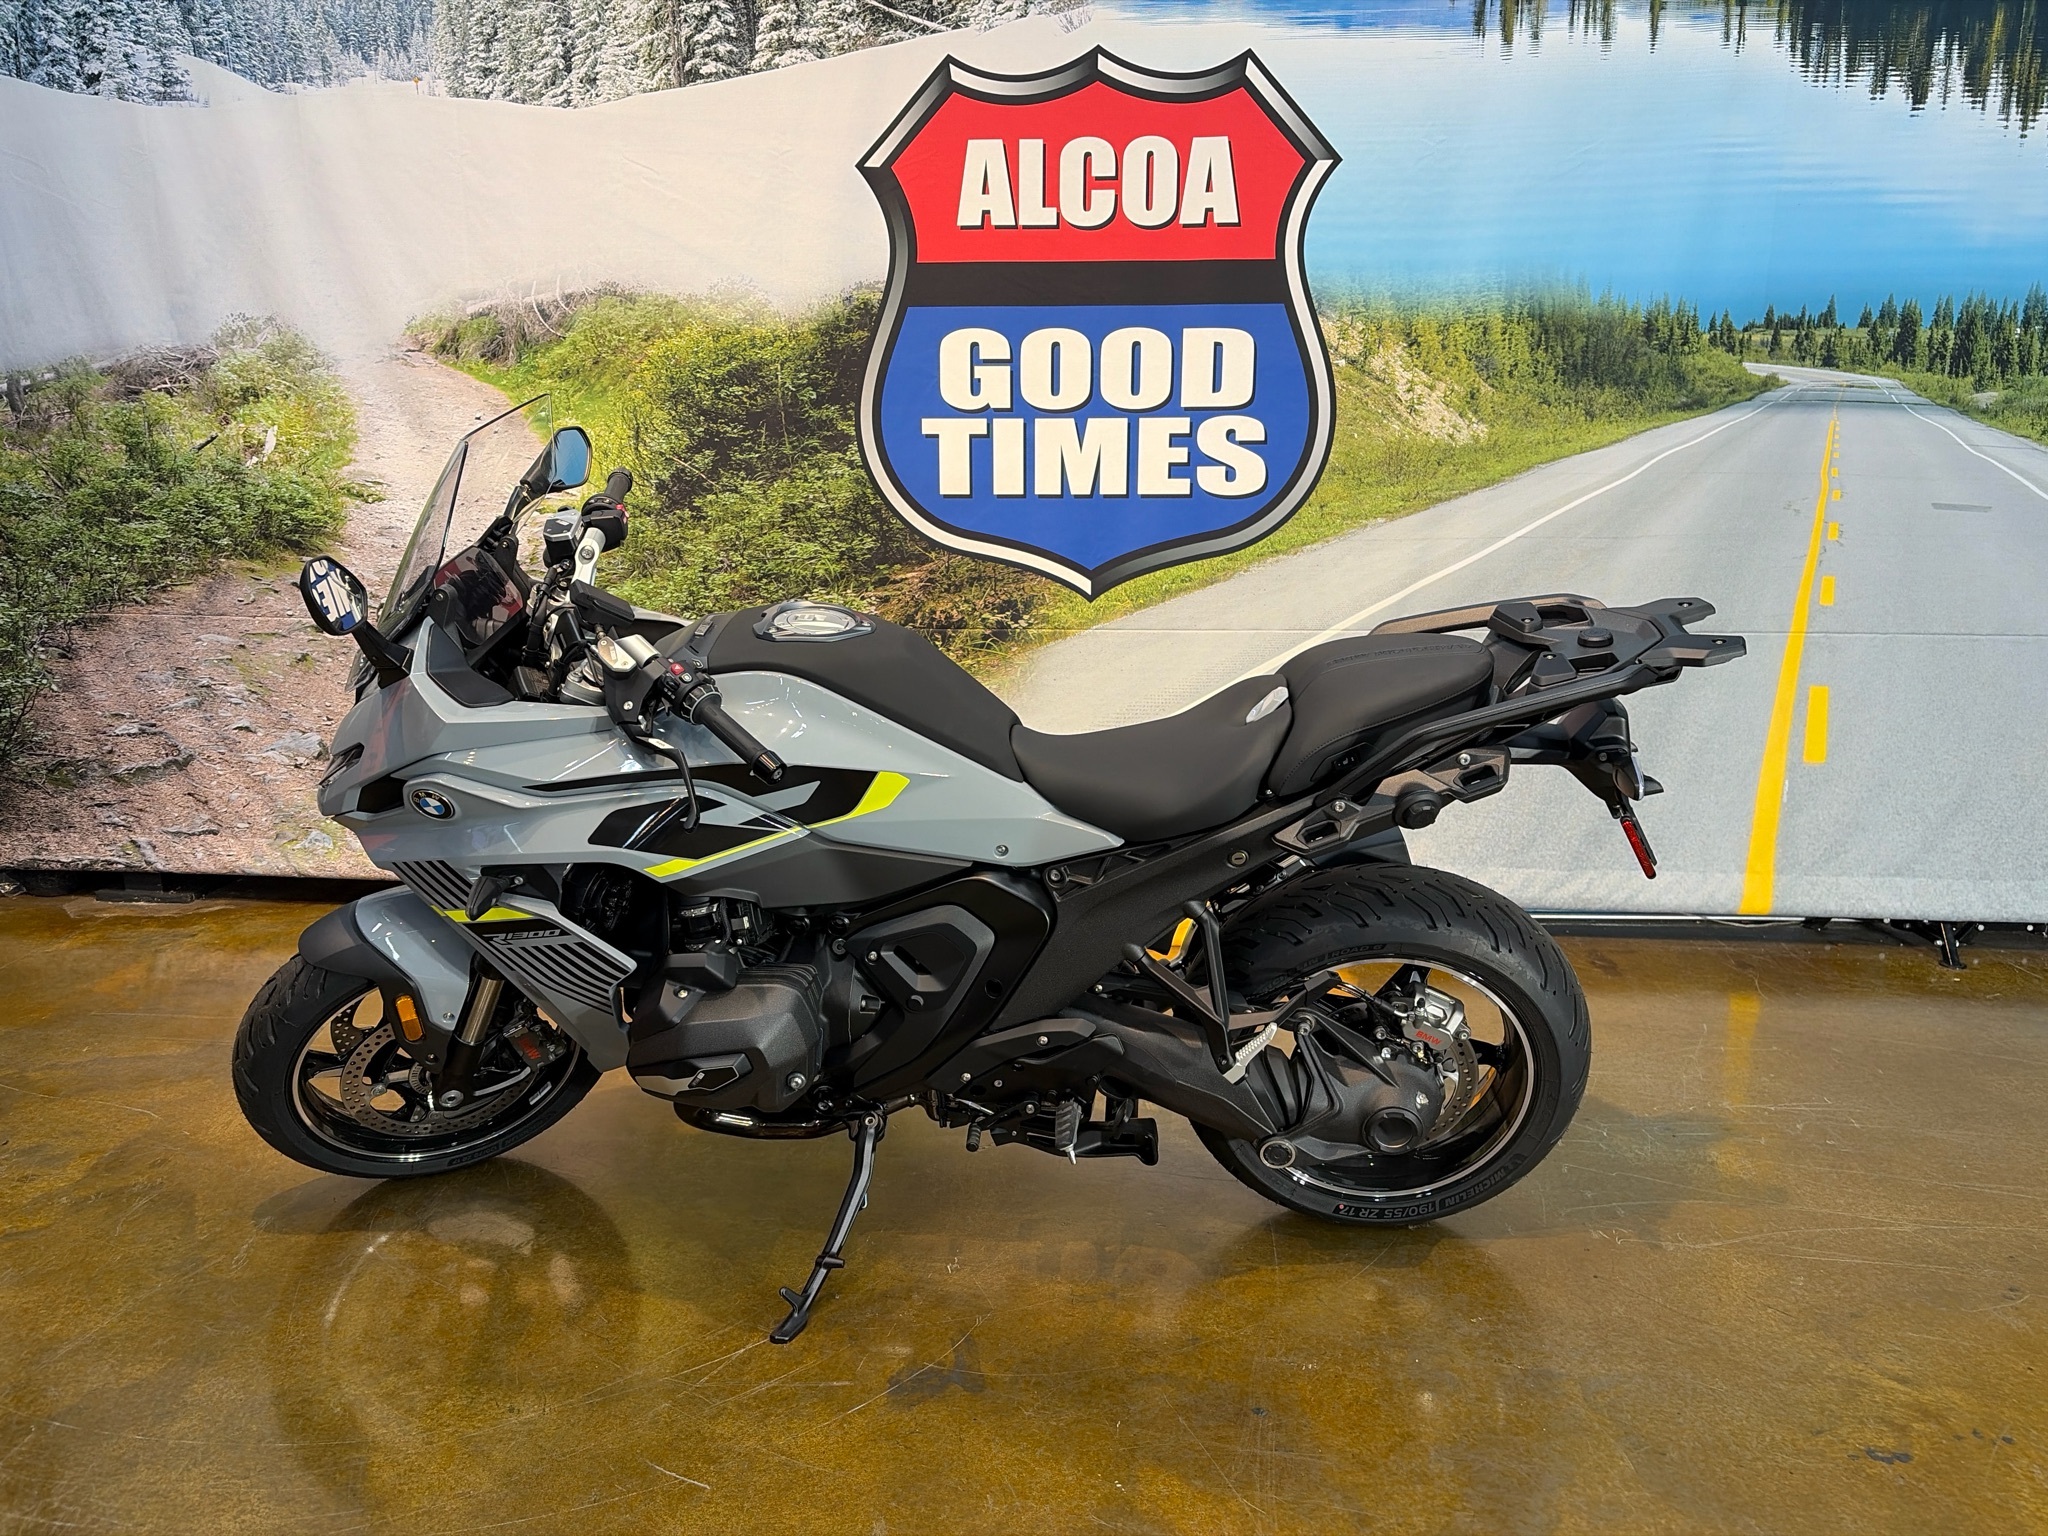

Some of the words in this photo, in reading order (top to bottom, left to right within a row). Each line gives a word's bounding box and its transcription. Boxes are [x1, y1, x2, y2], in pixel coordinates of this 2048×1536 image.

[956, 135, 1241, 230] ALCOA
[938, 327, 1256, 413] GOOD
[921, 415, 1268, 498] TIMES
[1416, 1030, 1441, 1045] BMW
[1444, 1168, 1506, 1207] MICHELIN
[1339, 1206, 1355, 1216] 17
[1359, 1208, 1379, 1219] ZR
[1384, 1203, 1434, 1219] 190/55
